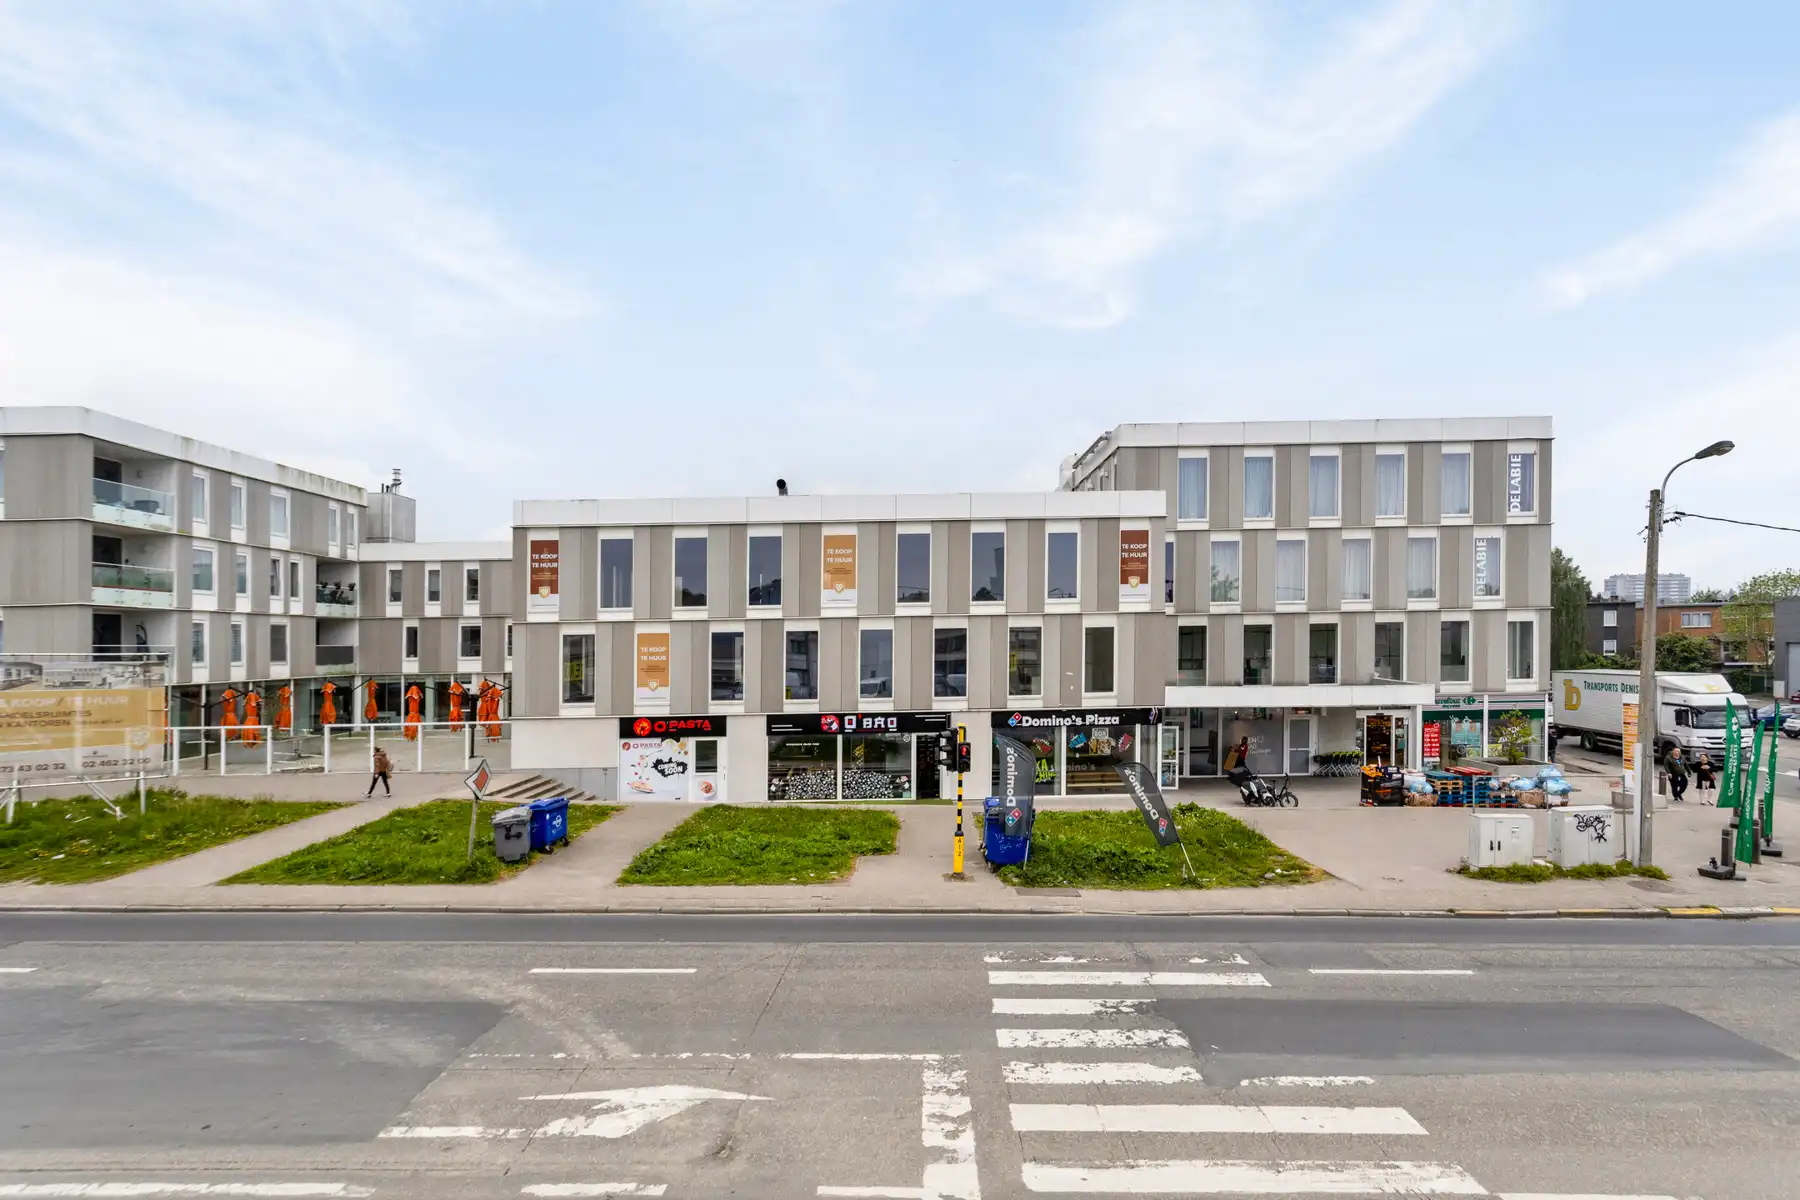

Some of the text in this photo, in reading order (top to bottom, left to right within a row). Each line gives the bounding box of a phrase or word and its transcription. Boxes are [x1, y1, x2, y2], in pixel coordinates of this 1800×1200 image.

[1510, 454, 1522, 512] DELABIE
[1475, 538, 1487, 595] DELABIE
[1584, 680, 1639, 694] TRANSPORTS DENIS
[6, 719, 71, 728] KANTOREN
[1022, 713, 1120, 727] Domino's Pizza
